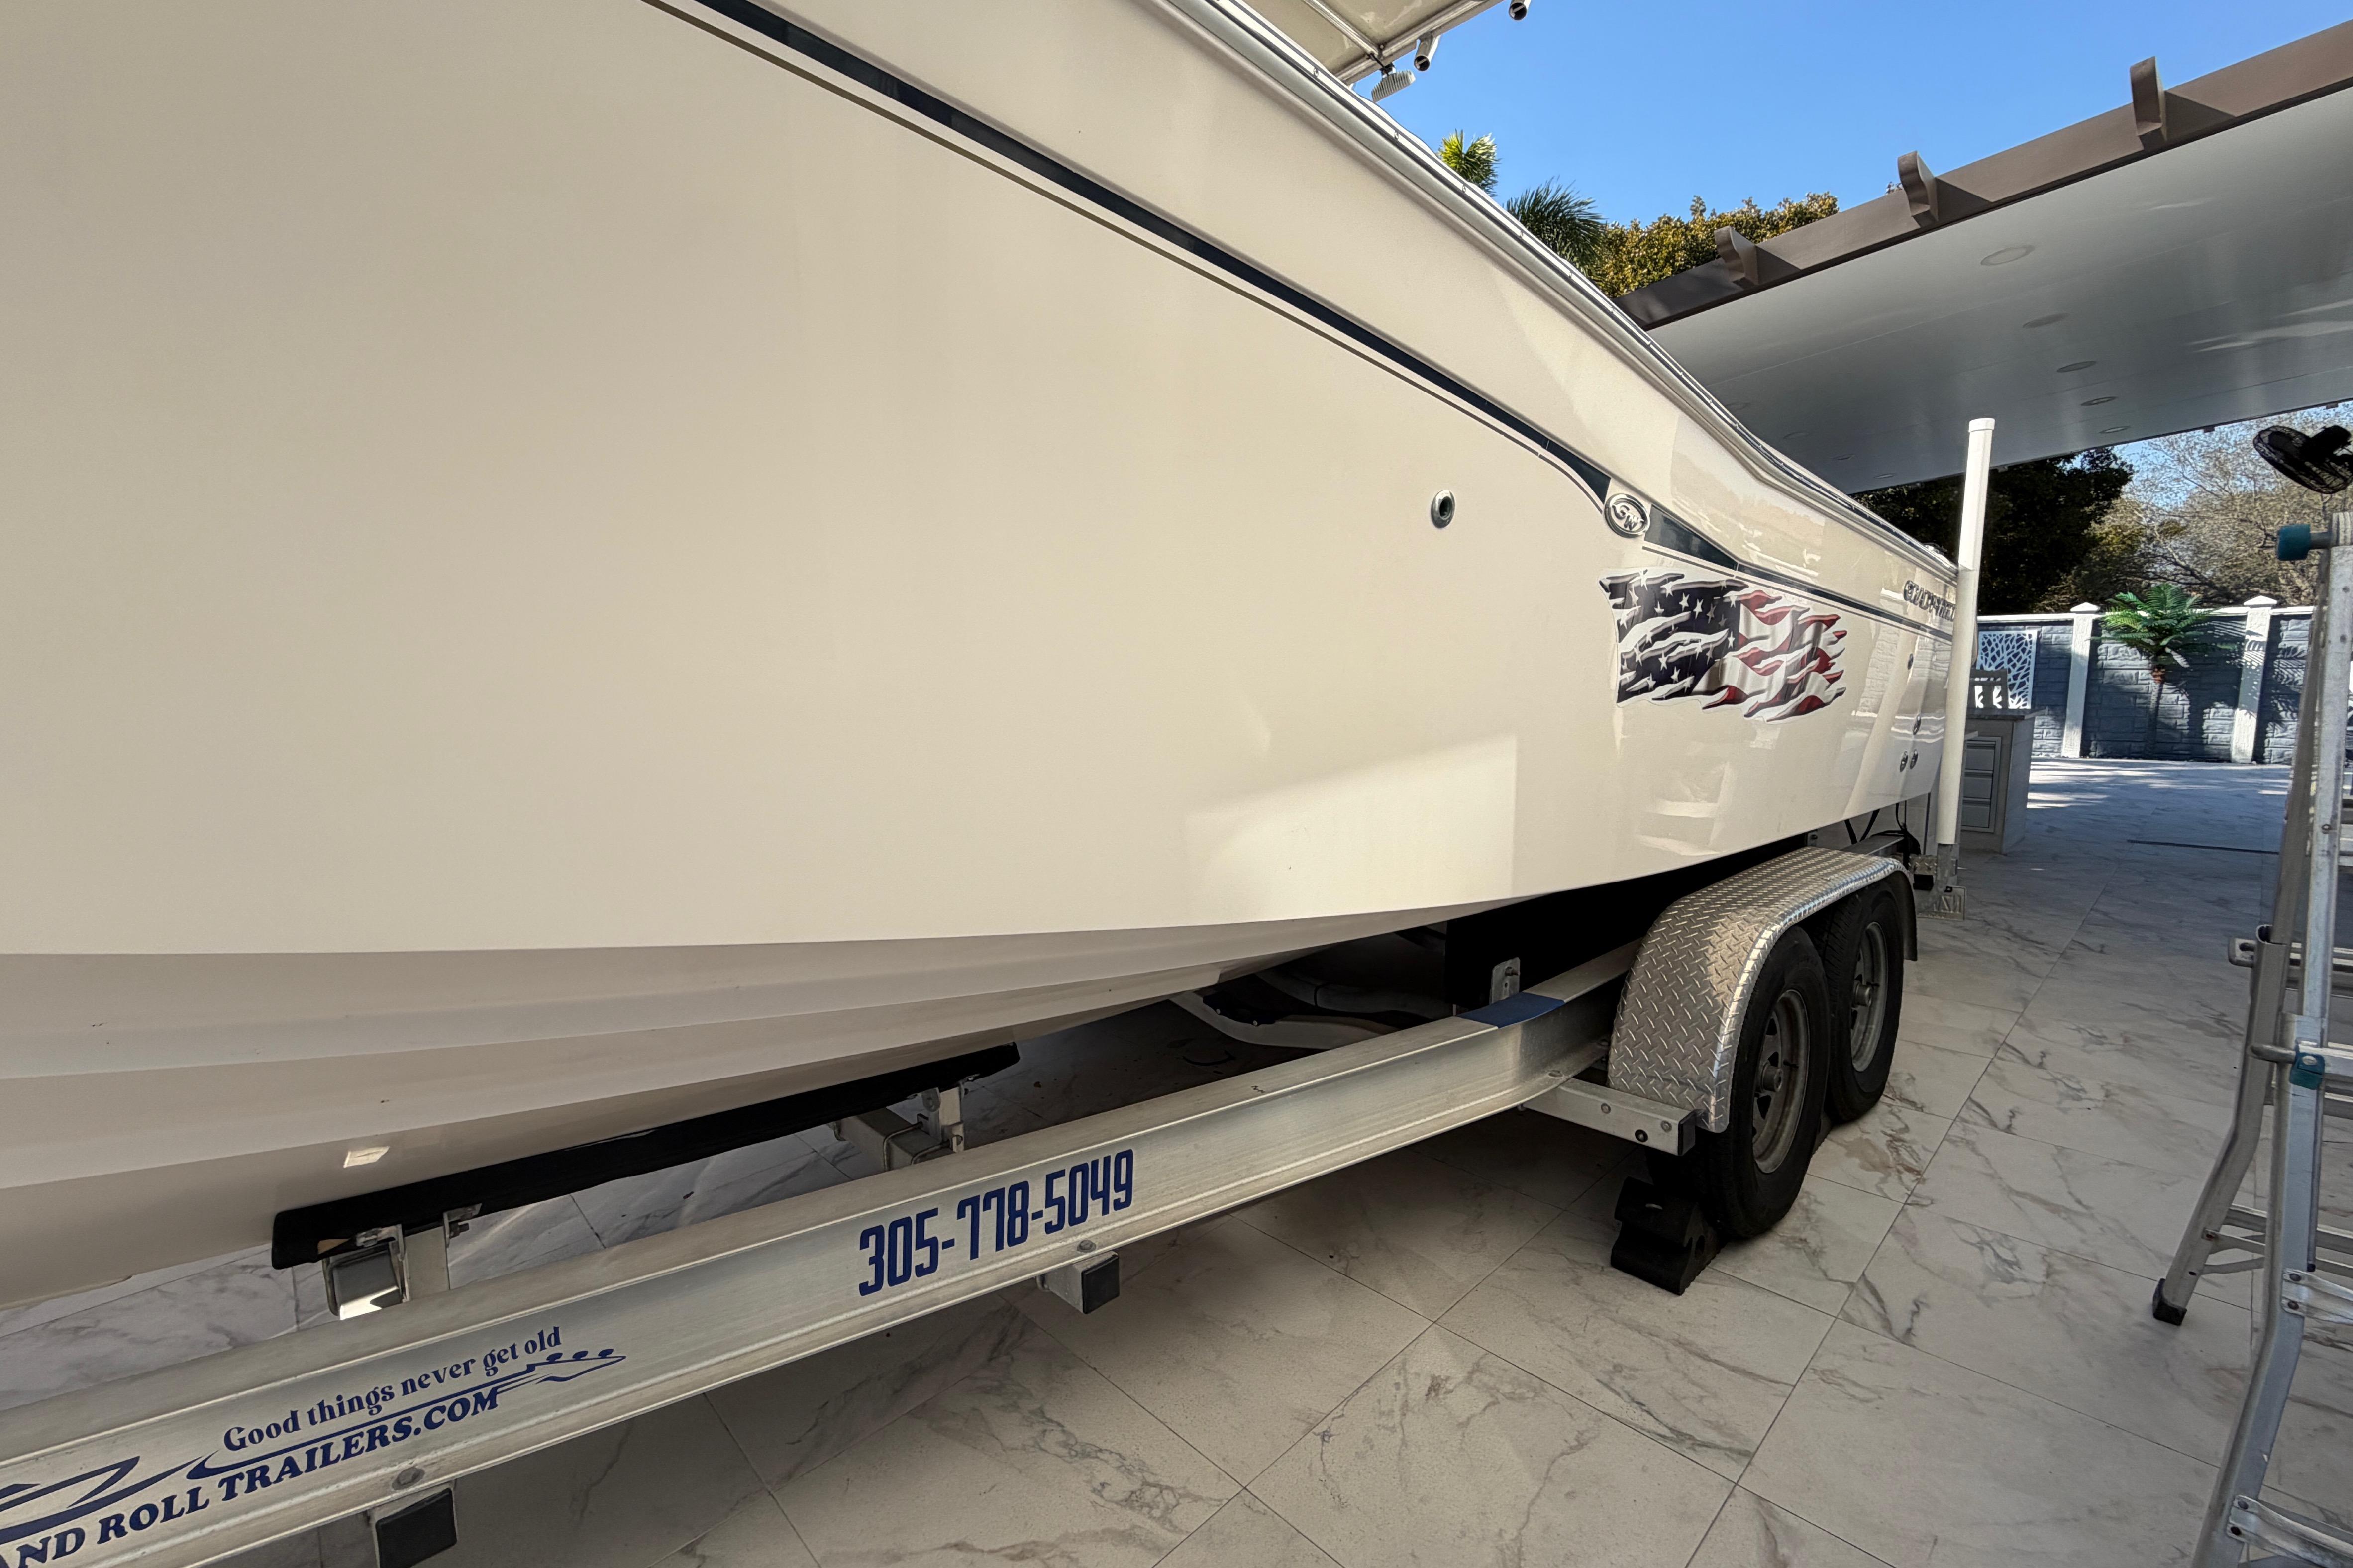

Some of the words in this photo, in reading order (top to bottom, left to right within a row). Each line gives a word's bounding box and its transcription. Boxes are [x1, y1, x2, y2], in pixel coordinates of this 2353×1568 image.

[859, 1149, 1133, 1296] 305-778-5049
[224, 1410, 300, 1451] Good
[307, 1385, 395, 1426] things
[401, 1358, 476, 1396] never
[482, 1343, 519, 1377] get
[524, 1326, 562, 1355] old
[97, 1486, 210, 1544] ROLL
[218, 1388, 498, 1501] TRAILERS.COM
